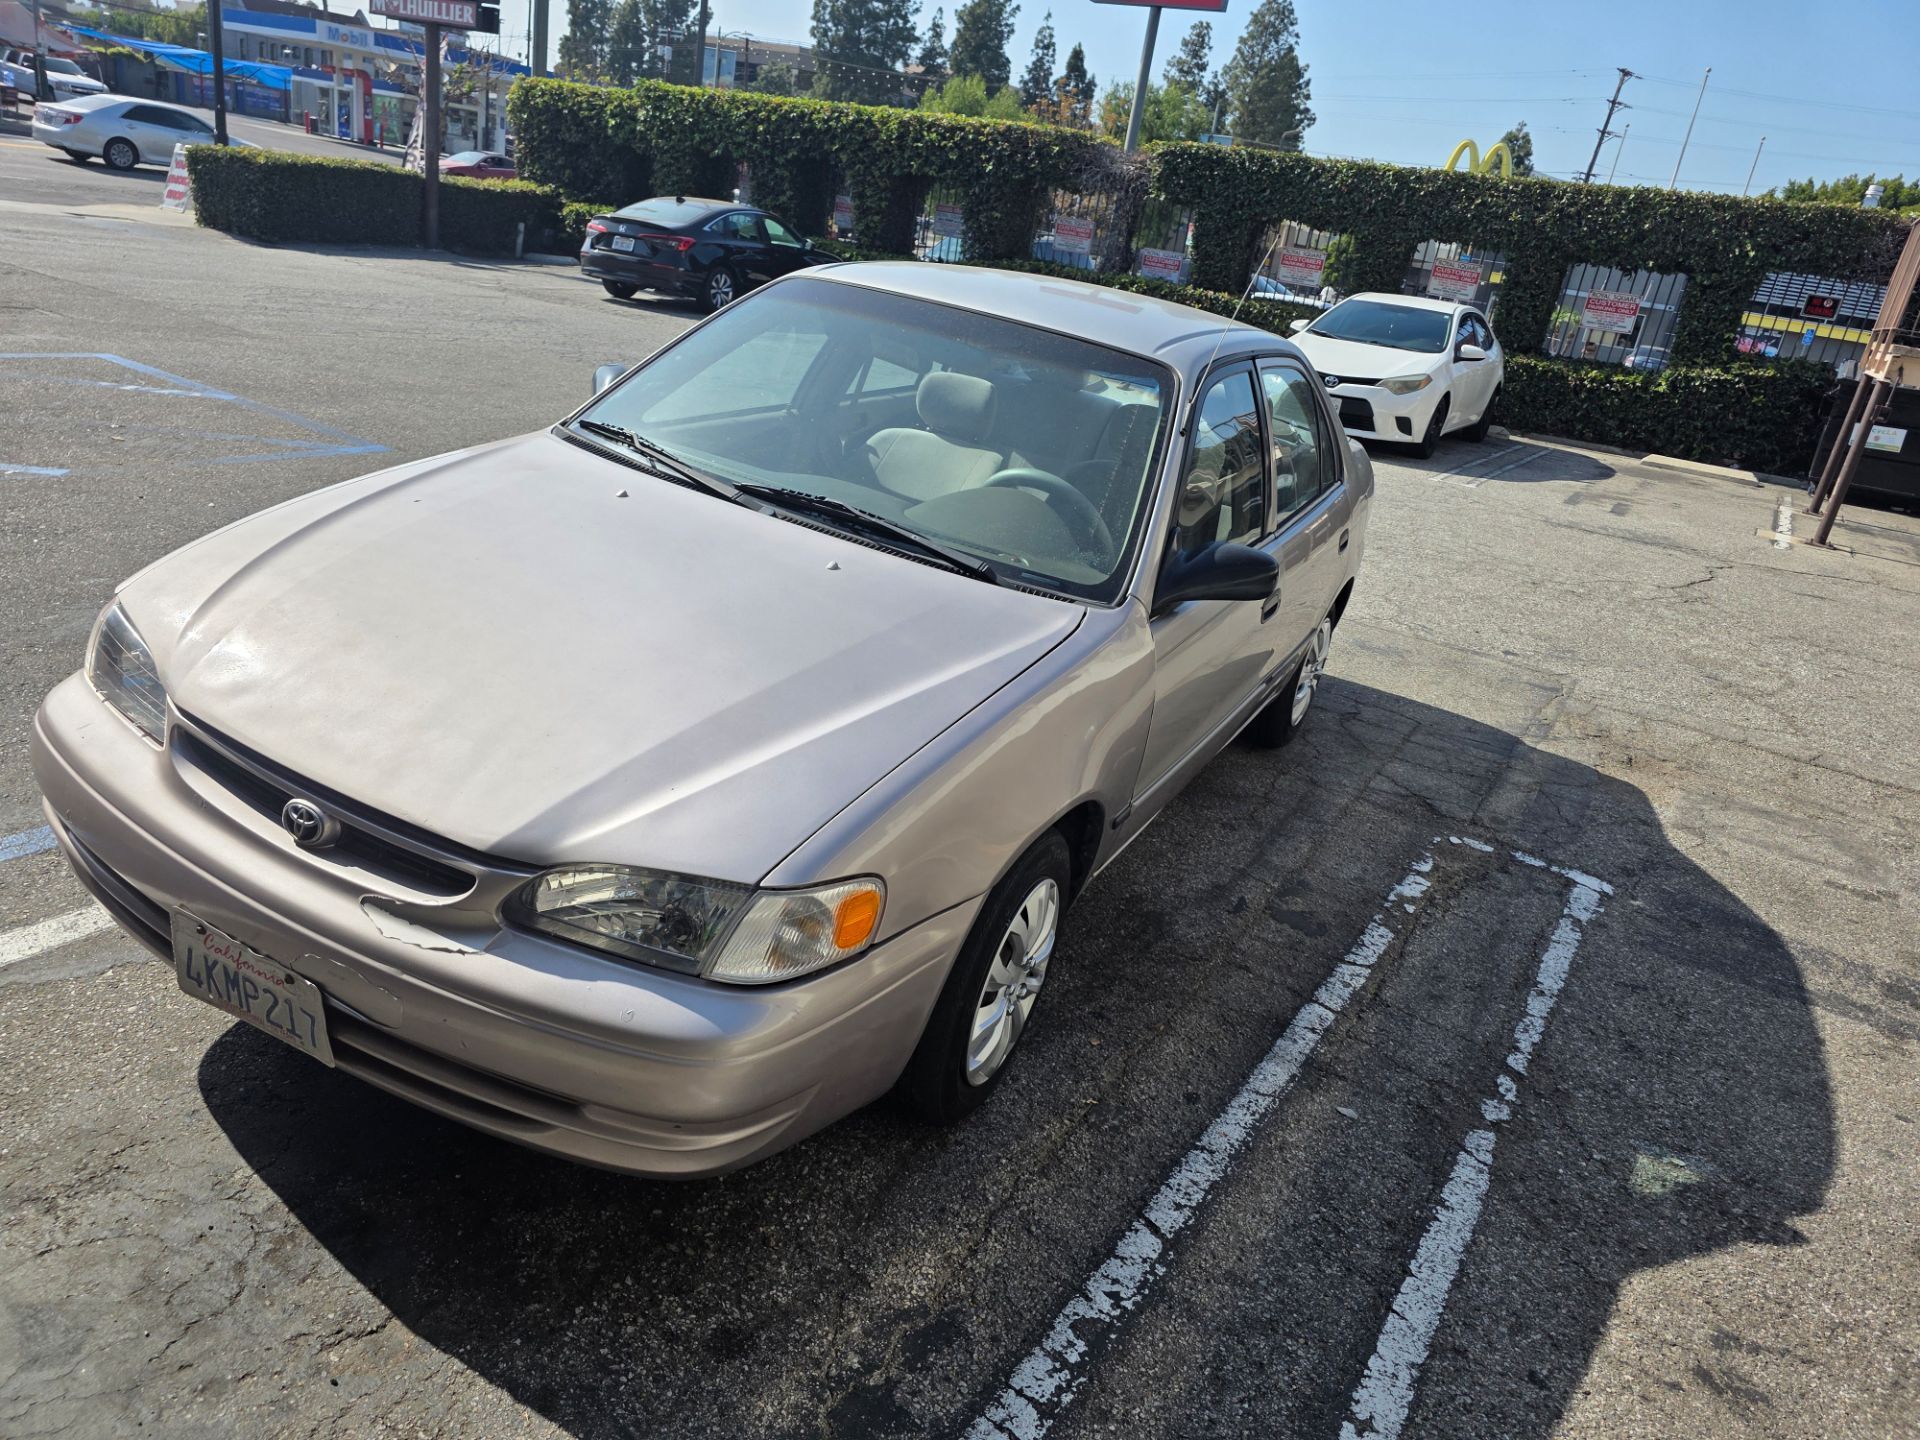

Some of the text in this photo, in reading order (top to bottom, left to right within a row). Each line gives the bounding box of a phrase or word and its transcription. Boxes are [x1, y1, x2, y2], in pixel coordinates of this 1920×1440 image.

[399, 0, 474, 24] LHUILLIER
[327, 26, 368, 48] Mobil
[1145, 255, 1180, 266] CUSTOMER
[1283, 254, 1323, 266] CUSTOMER
[1435, 266, 1478, 278] CUSTOMER
[1587, 304, 1635, 316] PARKING ONLY
[1589, 299, 1637, 310] CUSTOMER
[203, 932, 287, 989] California
[185, 946, 318, 1049] 4KMP217
